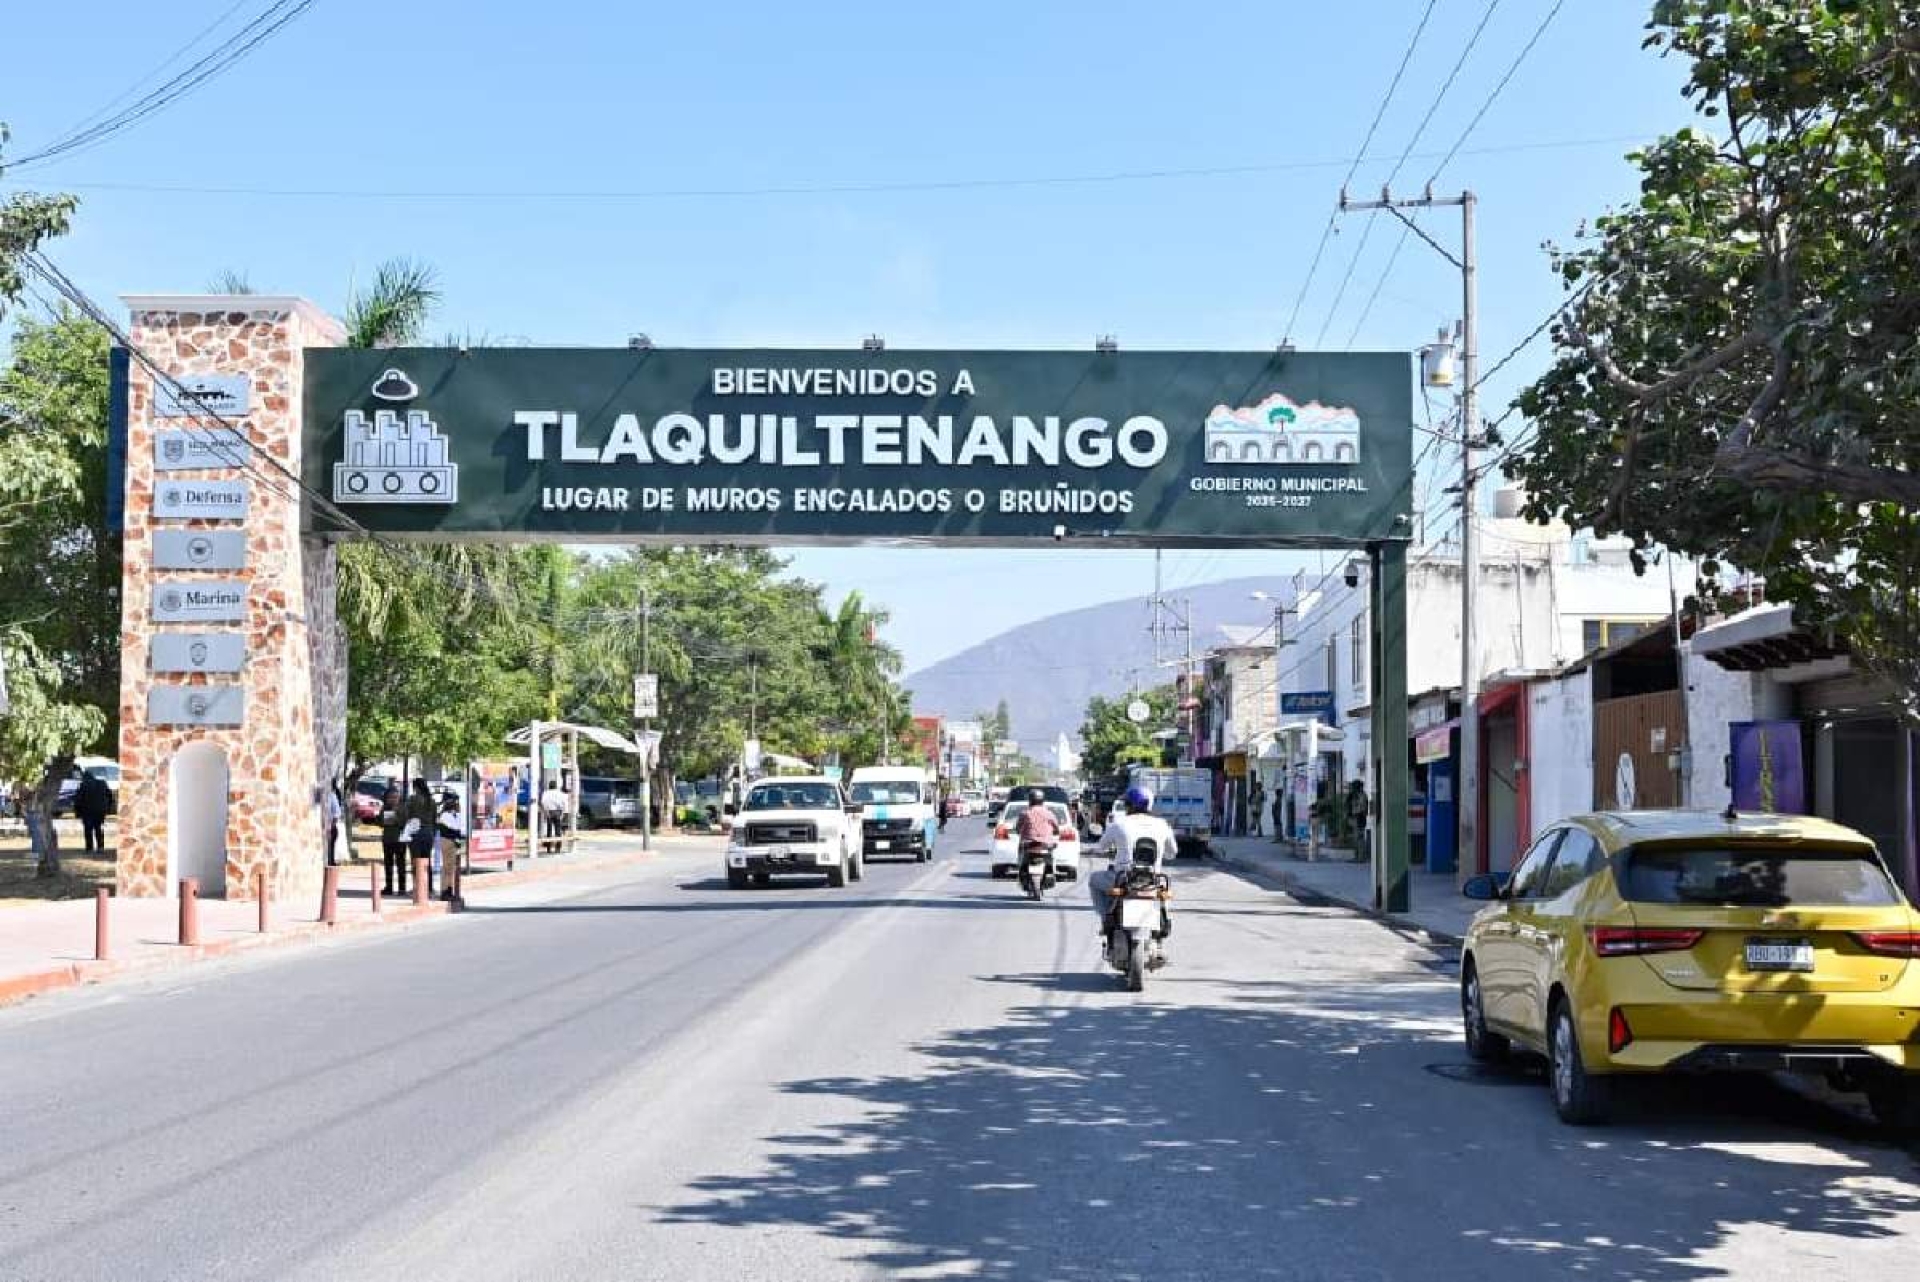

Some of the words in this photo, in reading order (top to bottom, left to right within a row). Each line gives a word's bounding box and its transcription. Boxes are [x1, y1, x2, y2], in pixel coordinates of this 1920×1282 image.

[713, 367, 937, 397] BIENVENIDOS
[952, 368, 976, 396] A
[514, 410, 1169, 468] TLAQUILTENANGO
[1190, 476, 1277, 491] GOBIERNO
[1280, 476, 1369, 492] MUNICIPAL
[186, 490, 242, 504] Defensa
[542, 487, 629, 511] LUGAR
[642, 487, 674, 511] DE
[687, 487, 781, 511] MUROS
[794, 487, 952, 512] ENCALADOS
[964, 489, 985, 512] O
[1000, 482, 1134, 513] BRUÑIDOS
[186, 591, 240, 605] Marina
